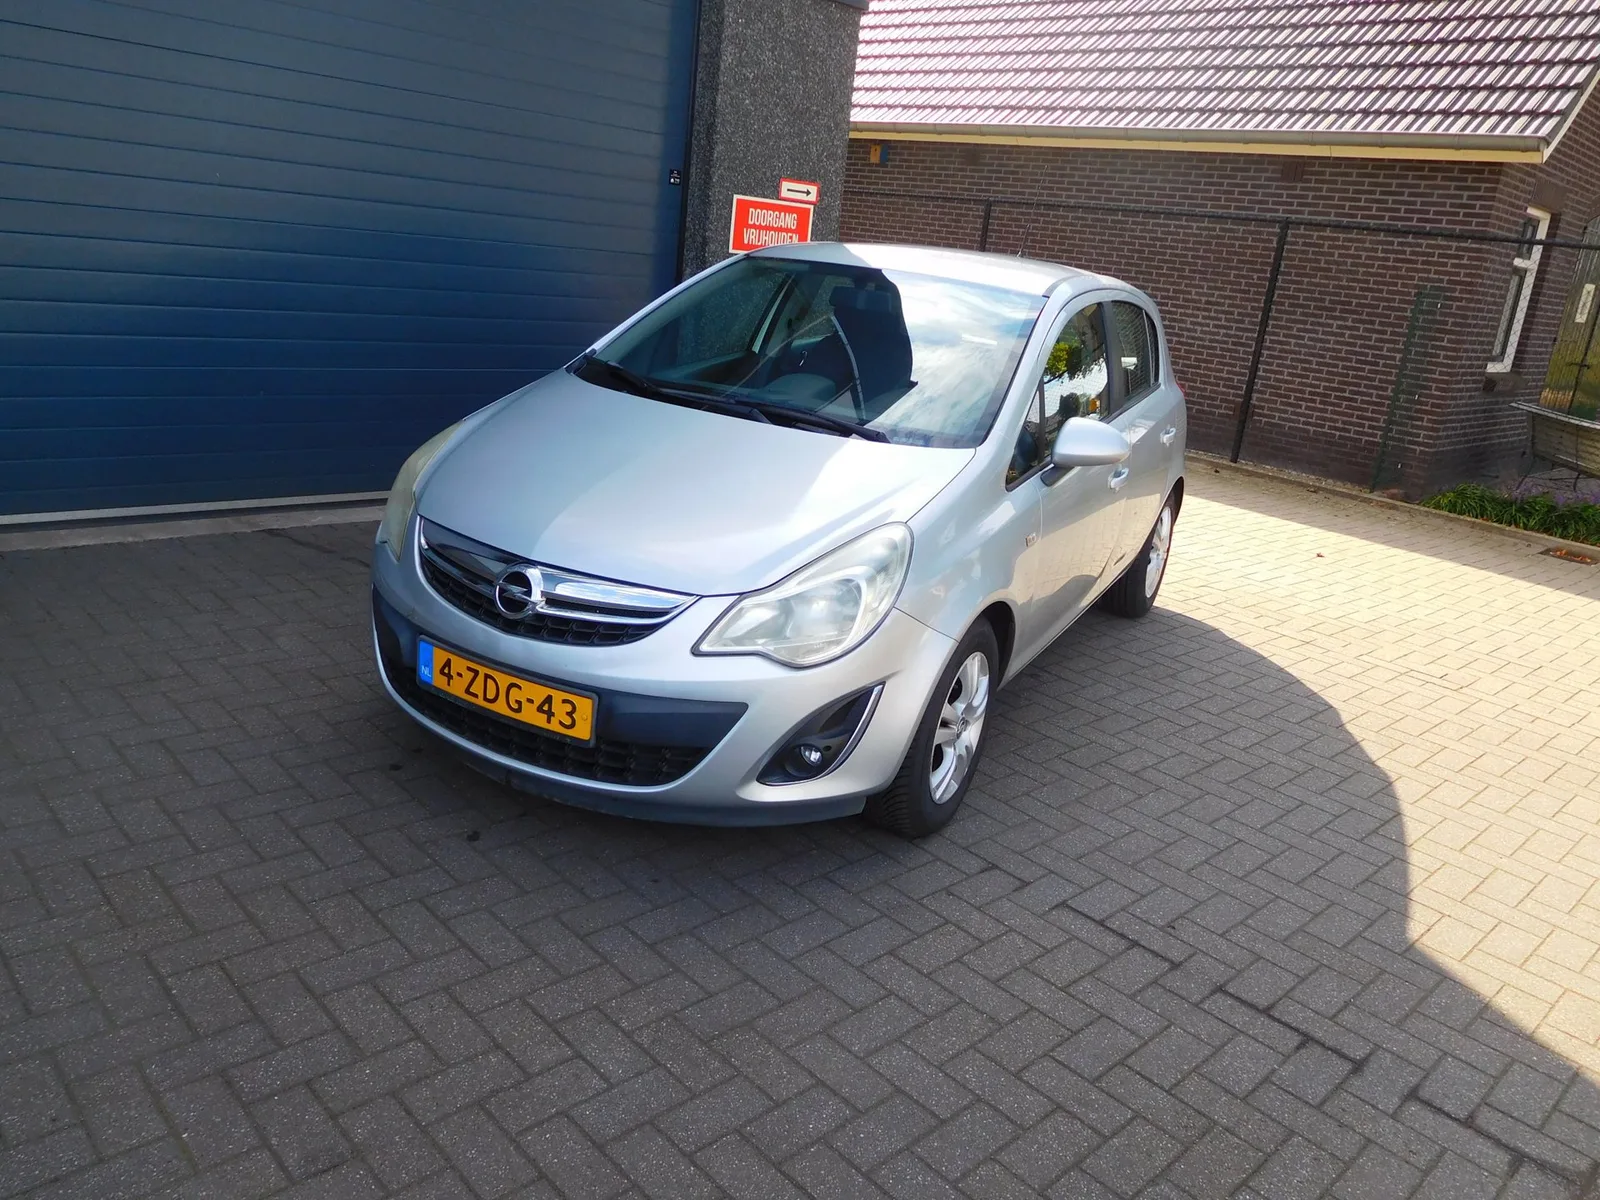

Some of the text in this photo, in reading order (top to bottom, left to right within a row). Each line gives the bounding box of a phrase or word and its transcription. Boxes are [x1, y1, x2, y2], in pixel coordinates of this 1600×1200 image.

[748, 208, 797, 229] DOORGANG
[421, 665, 432, 678] NL
[439, 657, 577, 730] 4-ZDG-43
